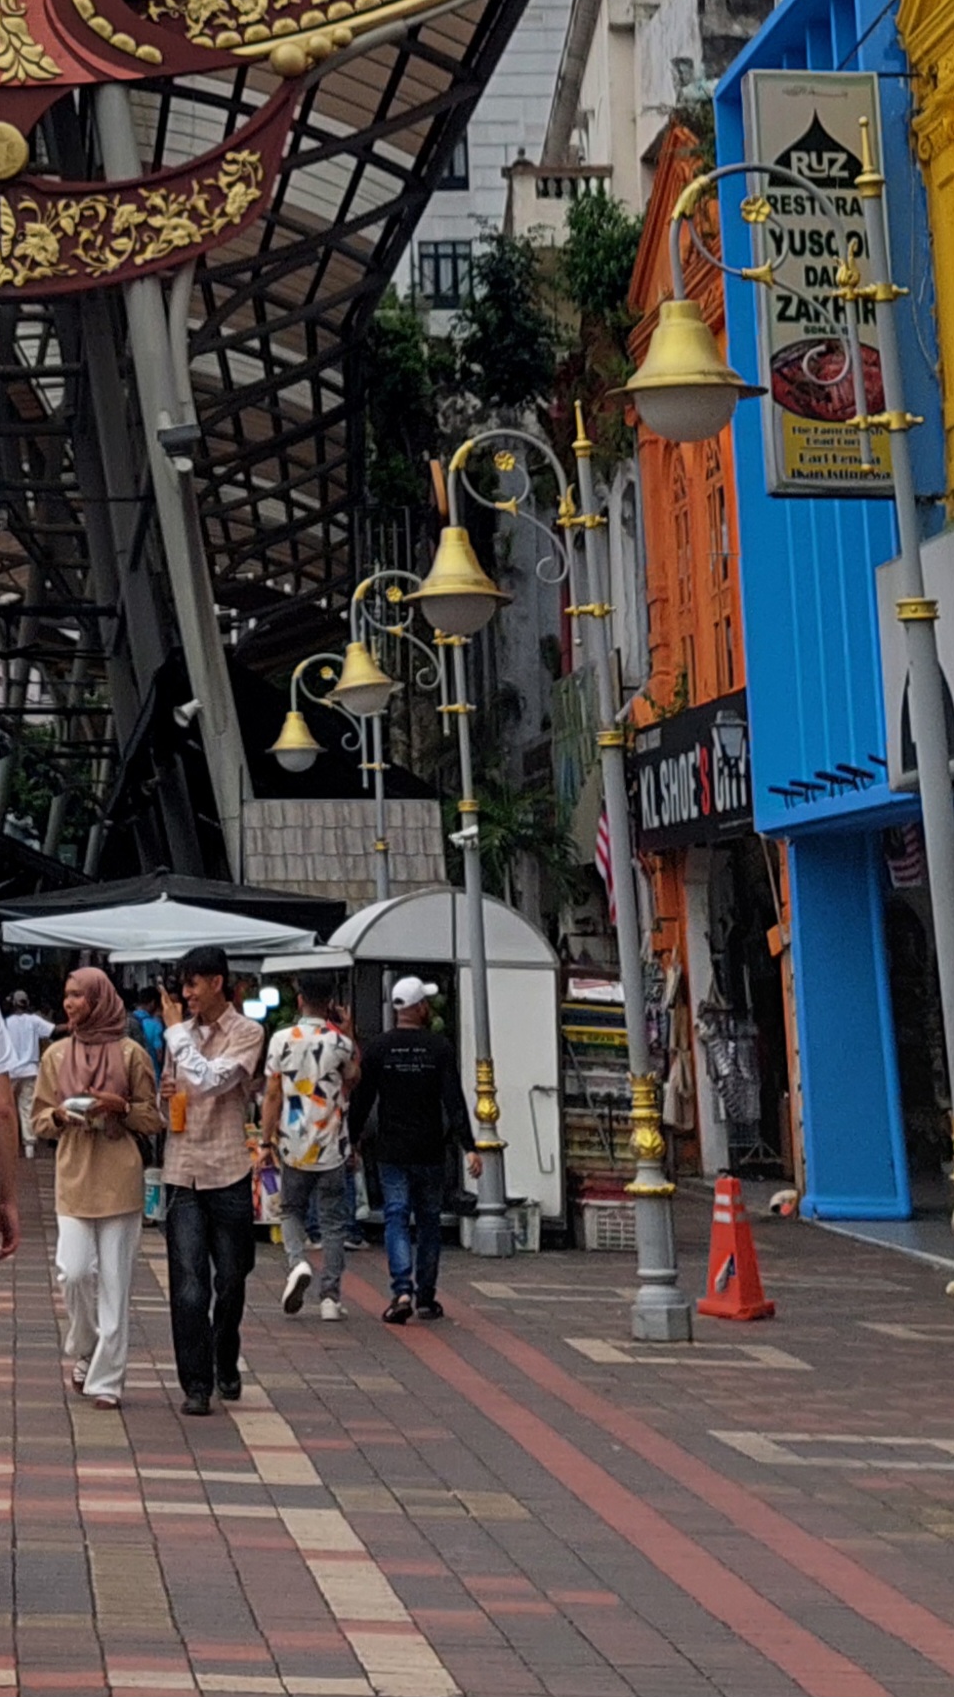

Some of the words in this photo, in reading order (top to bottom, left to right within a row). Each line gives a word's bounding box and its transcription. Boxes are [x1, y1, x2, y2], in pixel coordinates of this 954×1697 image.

[790, 151, 848, 178] RUZ
[639, 764, 660, 831] KL
[659, 742, 710, 827] SHOE'S
